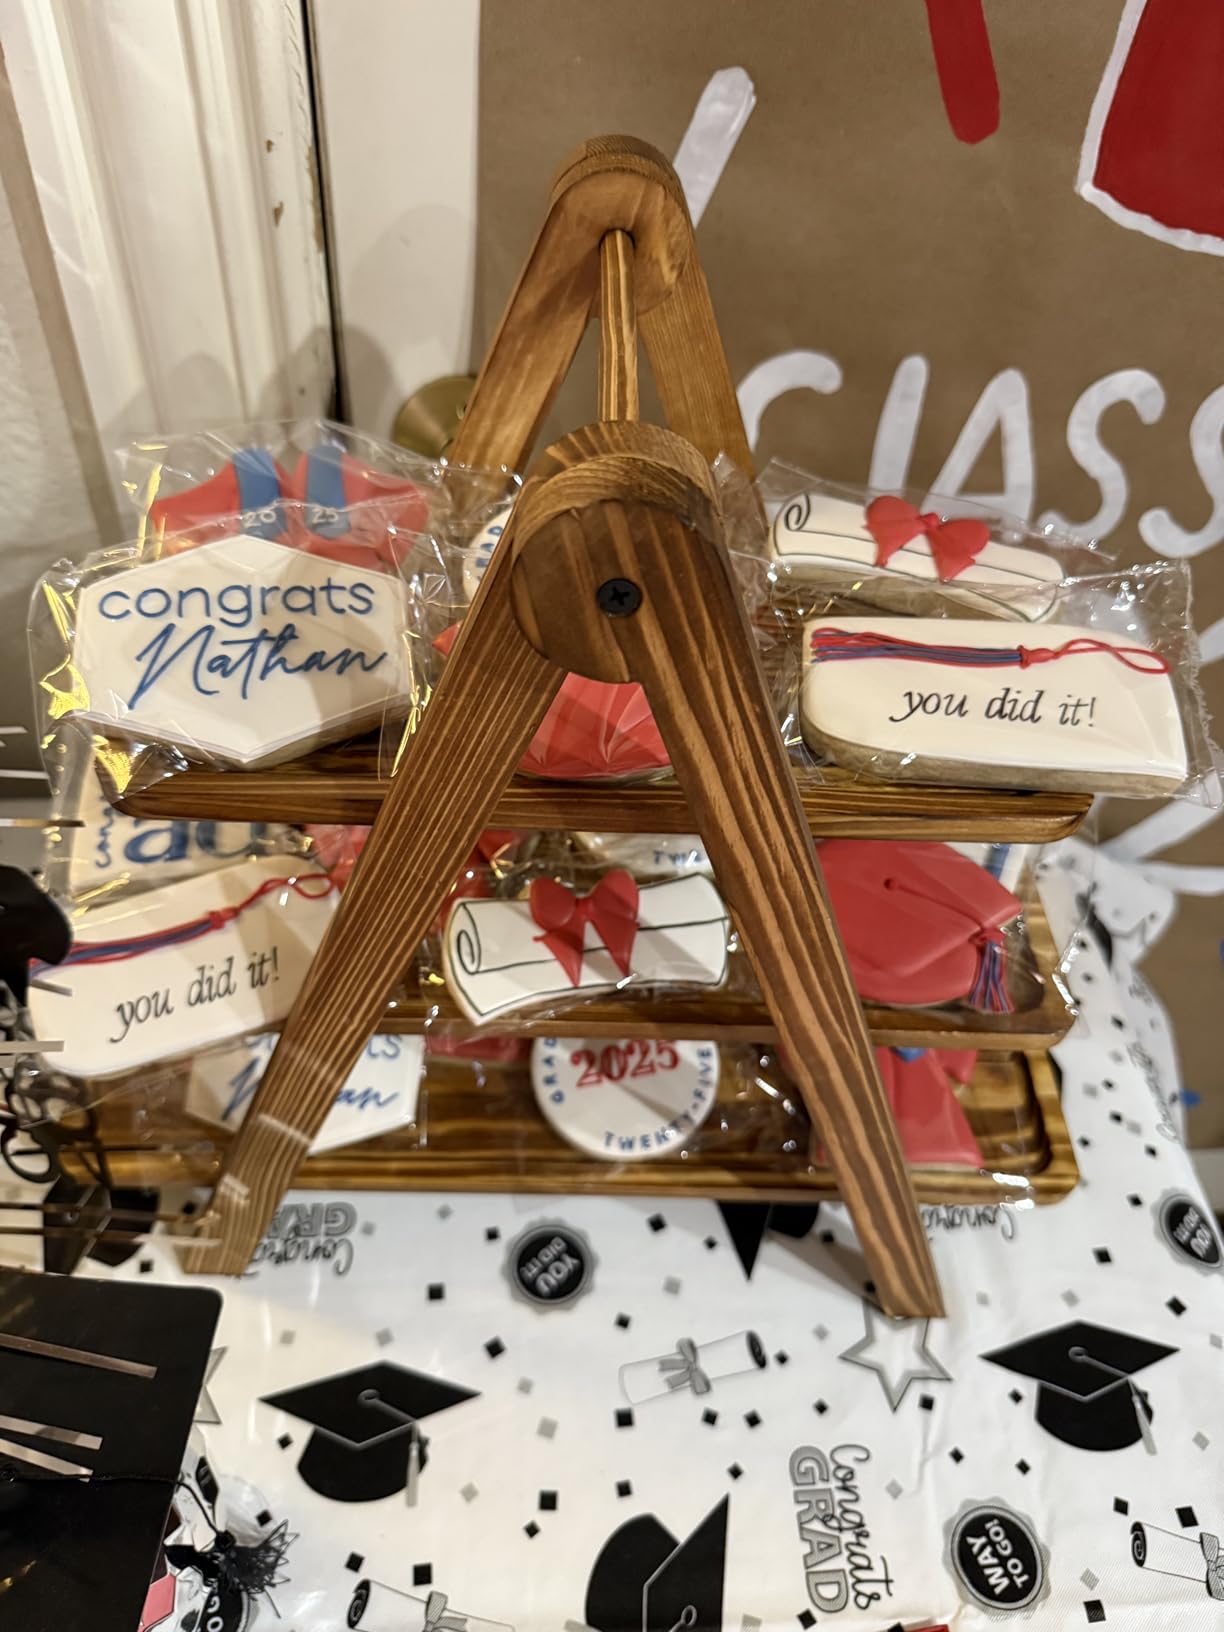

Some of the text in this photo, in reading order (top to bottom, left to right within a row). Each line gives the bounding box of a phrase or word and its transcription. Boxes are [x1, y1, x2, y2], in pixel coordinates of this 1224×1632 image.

[99, 577, 375, 627] congrats
[127, 622, 388, 711] Nathan
[889, 687, 1097, 727] you did it!
[109, 945, 281, 1043] you did it!
[570, 1038, 681, 1089] 2025
[536, 1253, 579, 1294] YOU
[538, 1236, 566, 1262] DID
[789, 1445, 850, 1614] GRAD
[821, 1443, 894, 1611] Congrats
[984, 1518, 1030, 1589] TO GO!
[965, 1535, 1011, 1595] WAY
